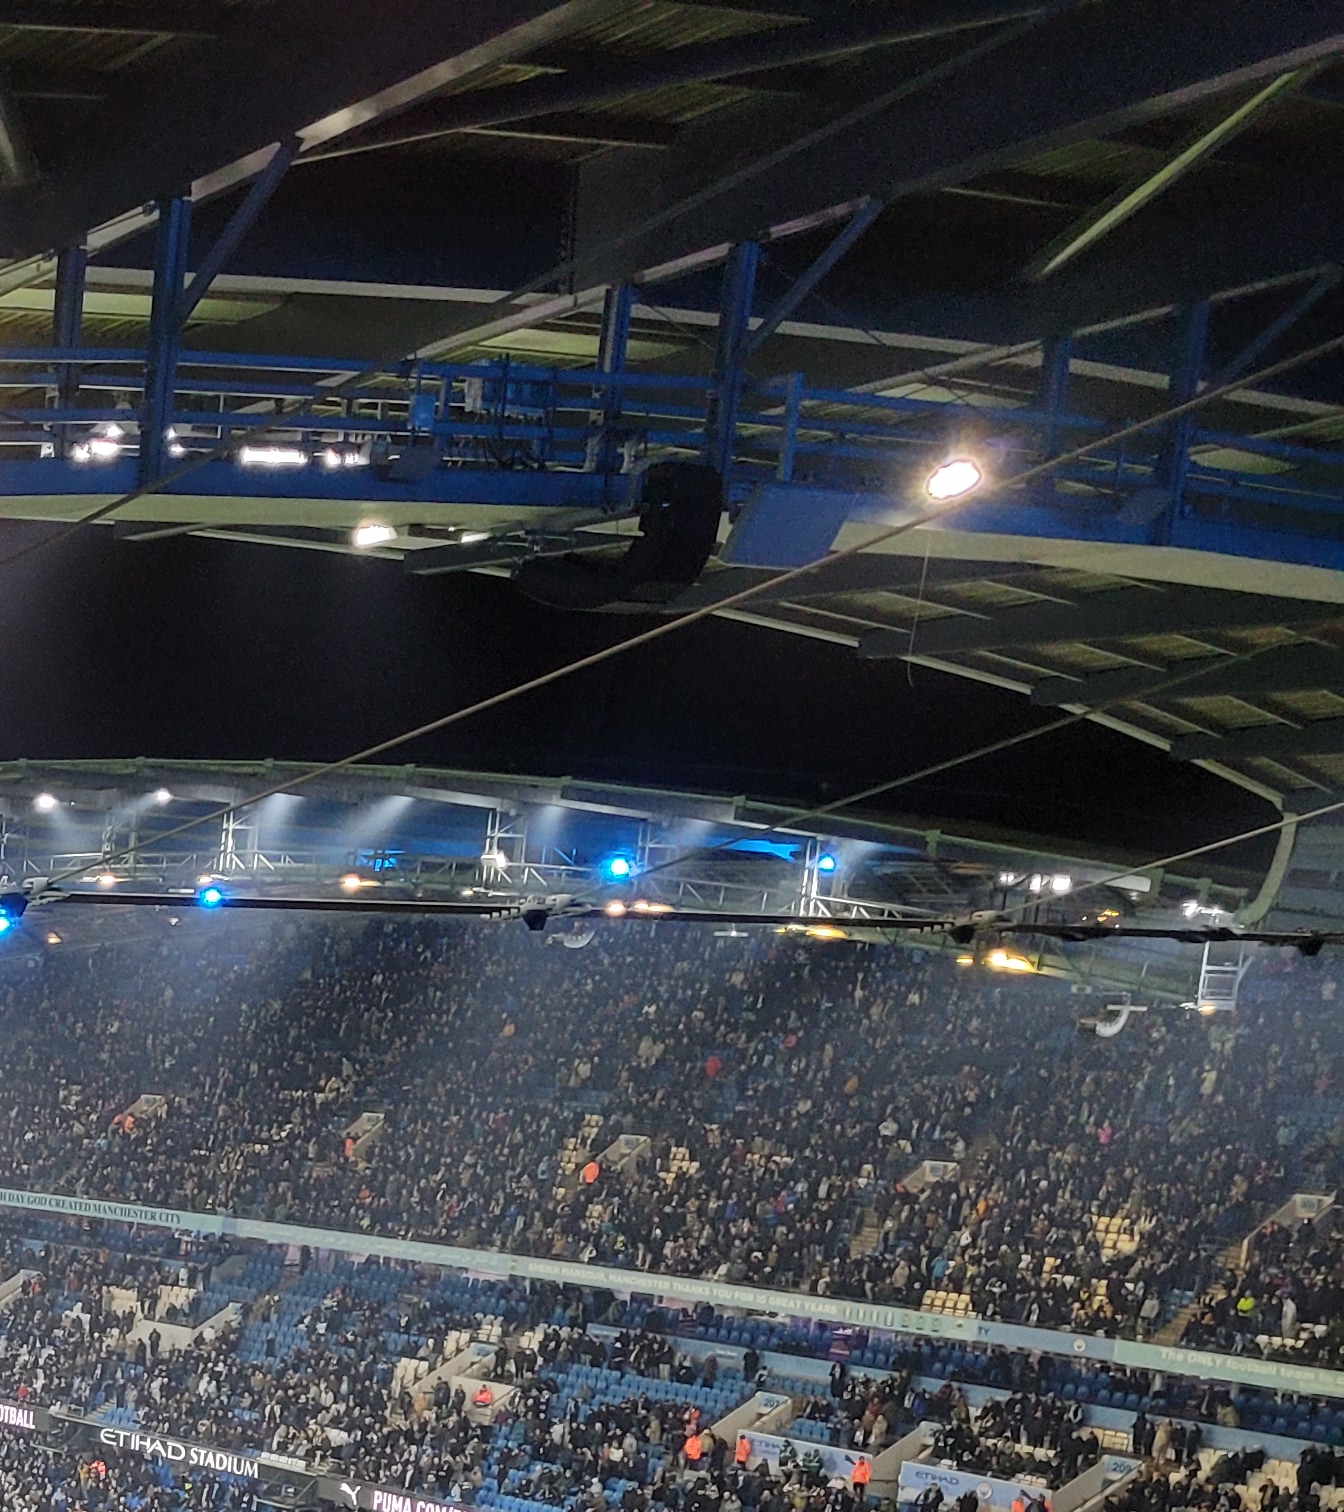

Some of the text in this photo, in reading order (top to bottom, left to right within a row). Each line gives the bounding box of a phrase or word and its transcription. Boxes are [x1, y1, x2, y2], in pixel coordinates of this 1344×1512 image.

[48, 1197, 91, 1213] CREATED
[93, 1203, 156, 1221] MANCHESTER
[100, 1428, 259, 1479] ETIHAD STADIUM
[915, 1470, 960, 1486] ETIHAD
